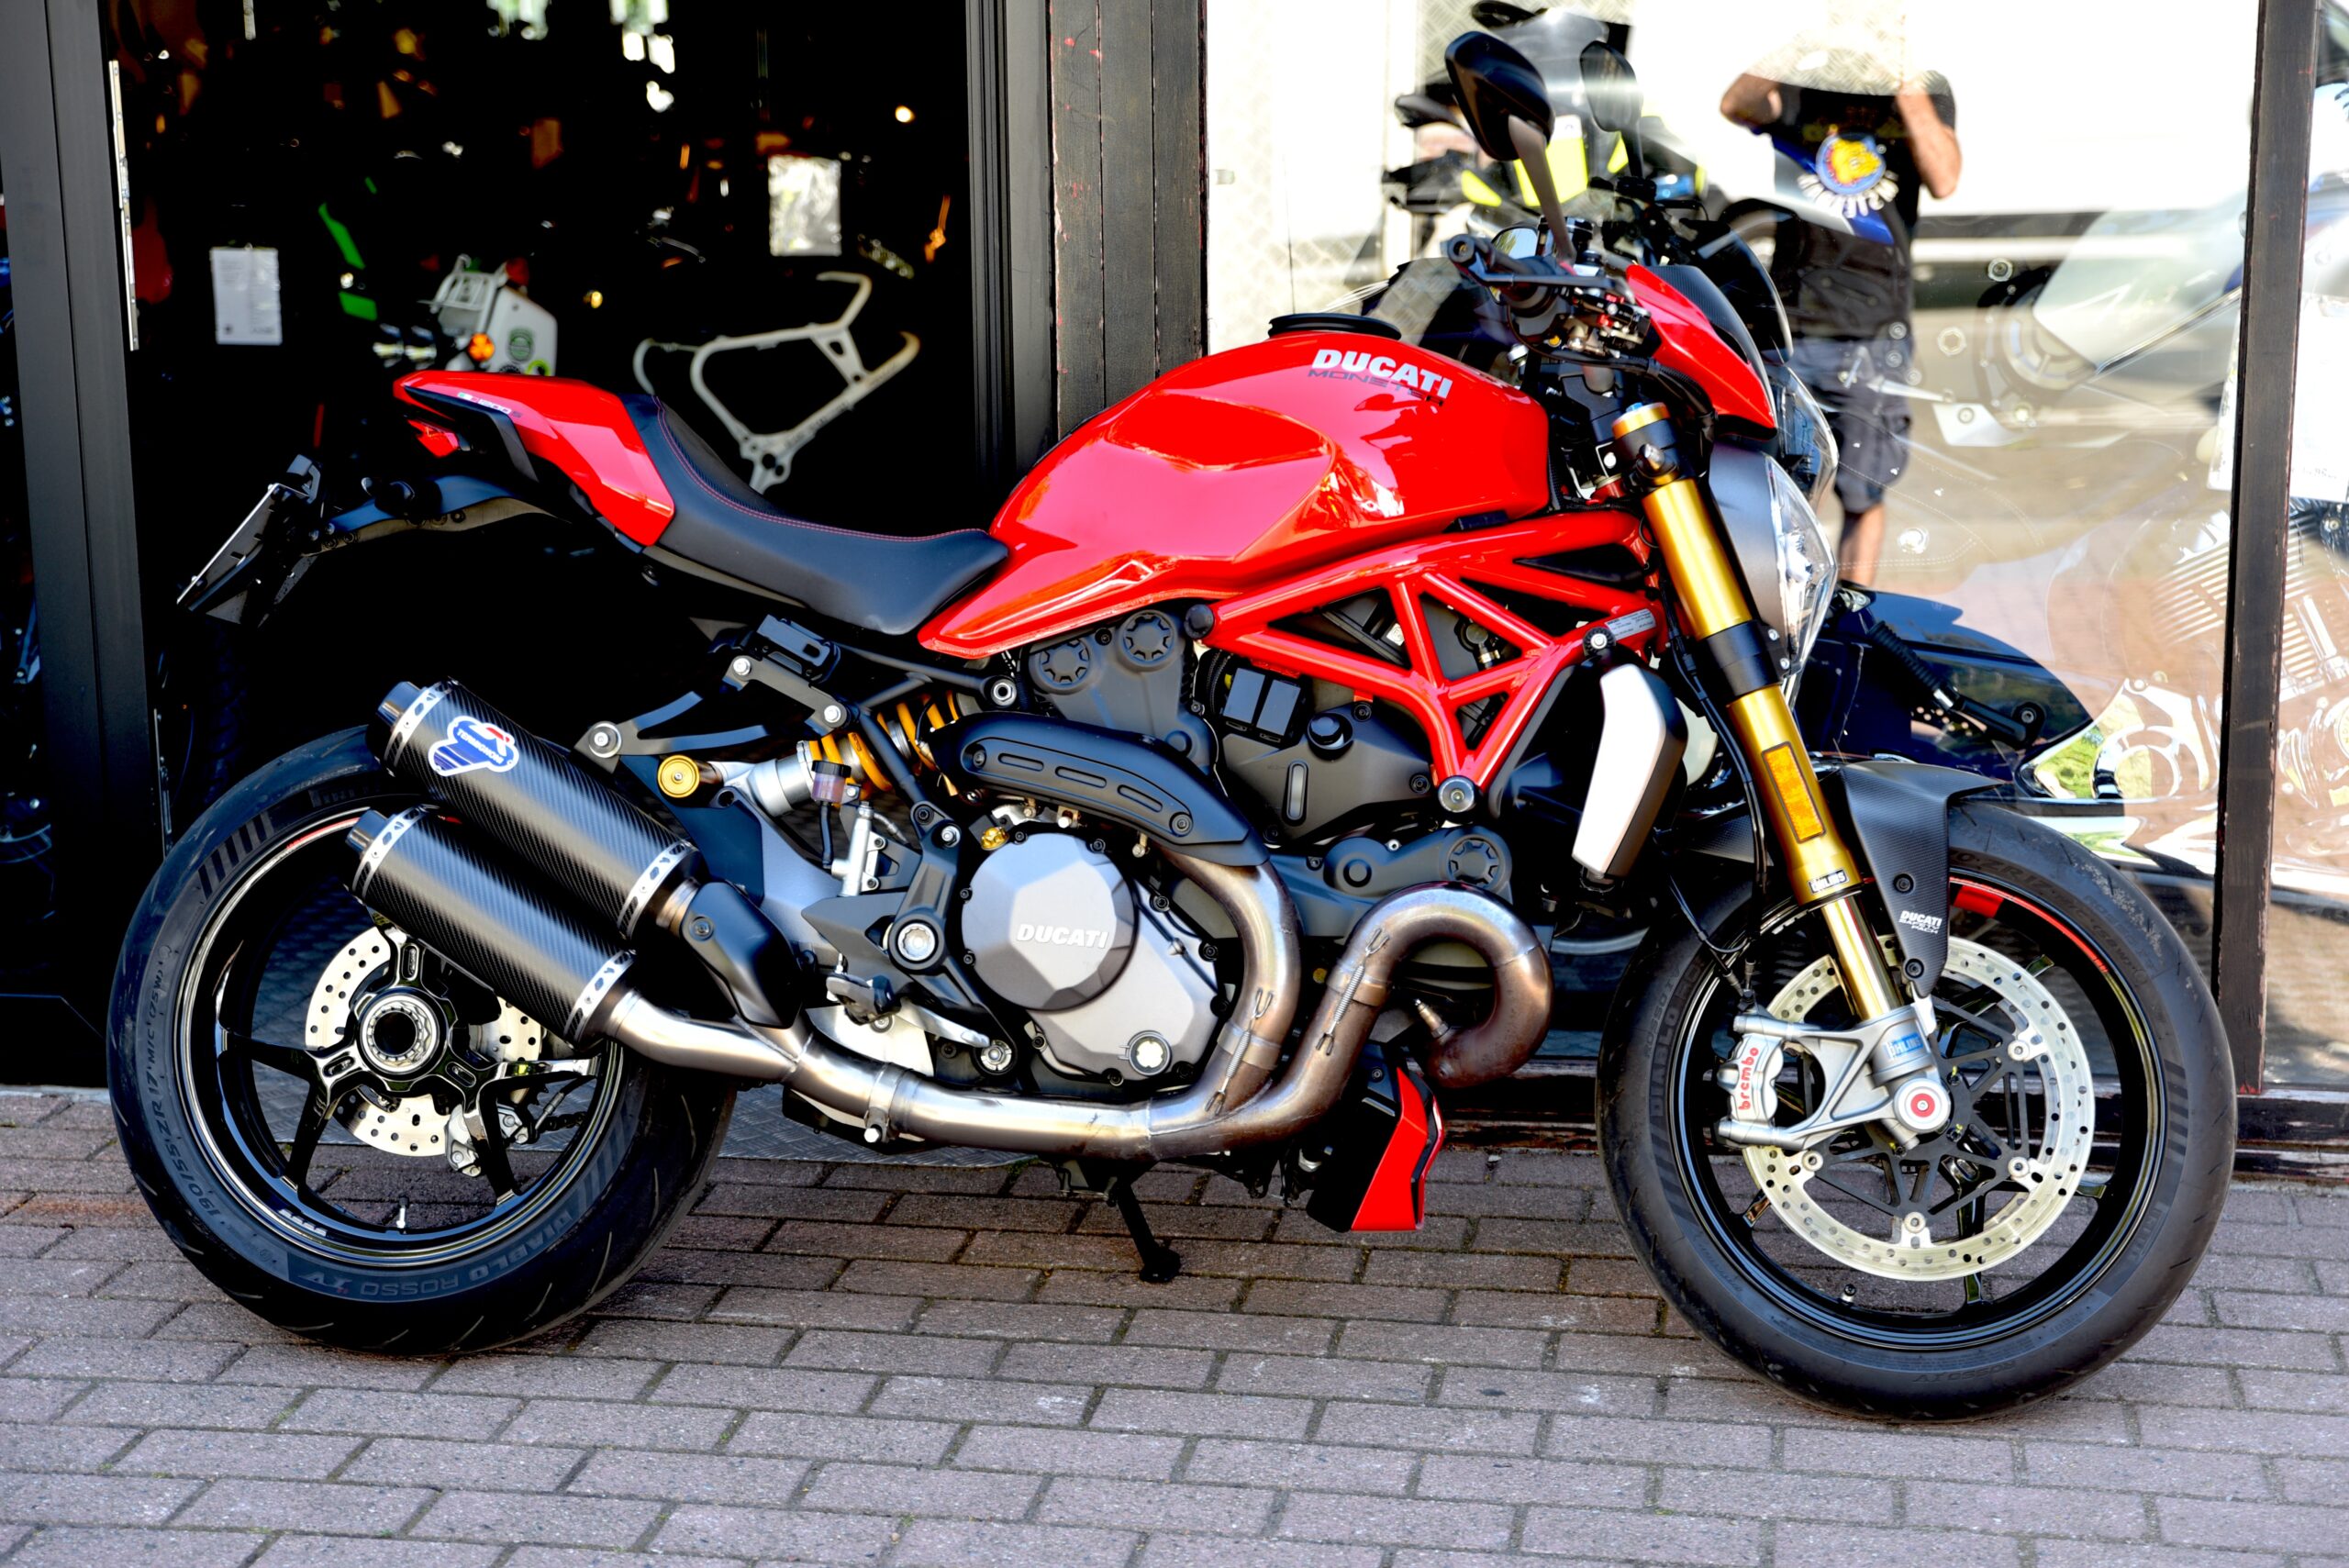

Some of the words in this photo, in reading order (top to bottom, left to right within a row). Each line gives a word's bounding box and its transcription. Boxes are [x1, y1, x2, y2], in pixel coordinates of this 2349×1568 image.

[1308, 370, 1444, 406] MONSTER
[1312, 349, 1453, 399] DUCATI
[478, 398, 512, 414] 1200
[1900, 910, 1943, 927] DUCATI
[1016, 924, 1109, 949] DUCATI
[1738, 1047, 1759, 1110] brembo
[468, 1208, 573, 1283] DIABLO
[359, 1273, 461, 1296] ROSSO
